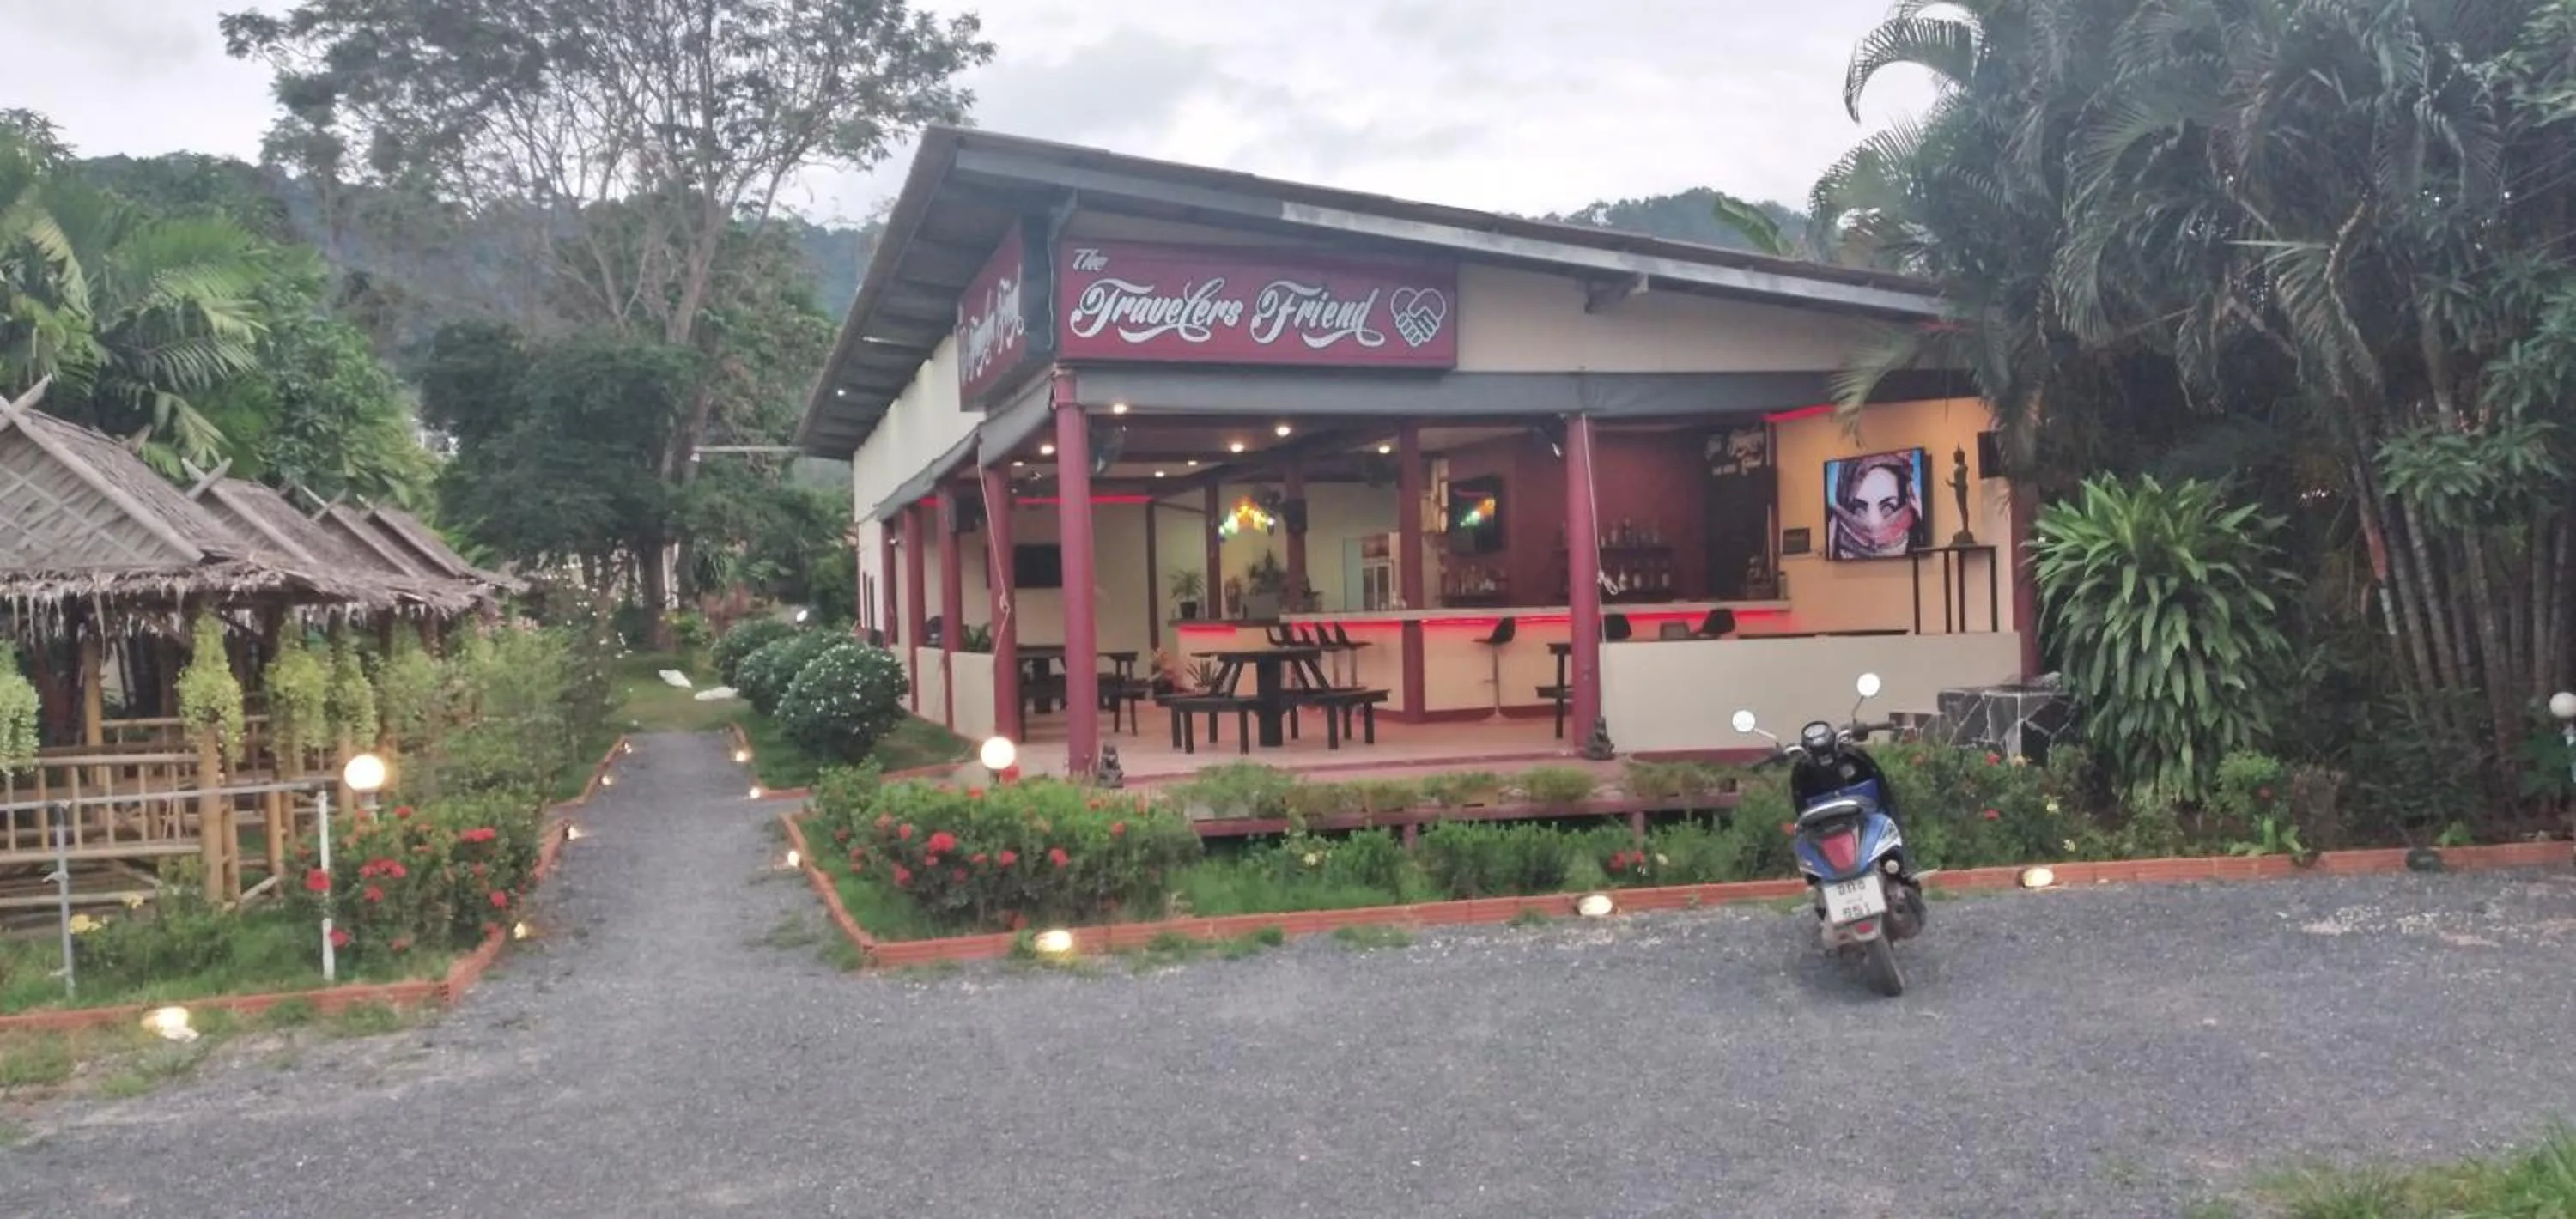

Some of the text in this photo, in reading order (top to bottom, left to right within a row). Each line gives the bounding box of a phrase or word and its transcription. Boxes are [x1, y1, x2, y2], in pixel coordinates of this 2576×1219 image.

[1073, 248, 1109, 271] The
[1070, 277, 1243, 343] Travelers
[1250, 281, 1385, 349] Friend
